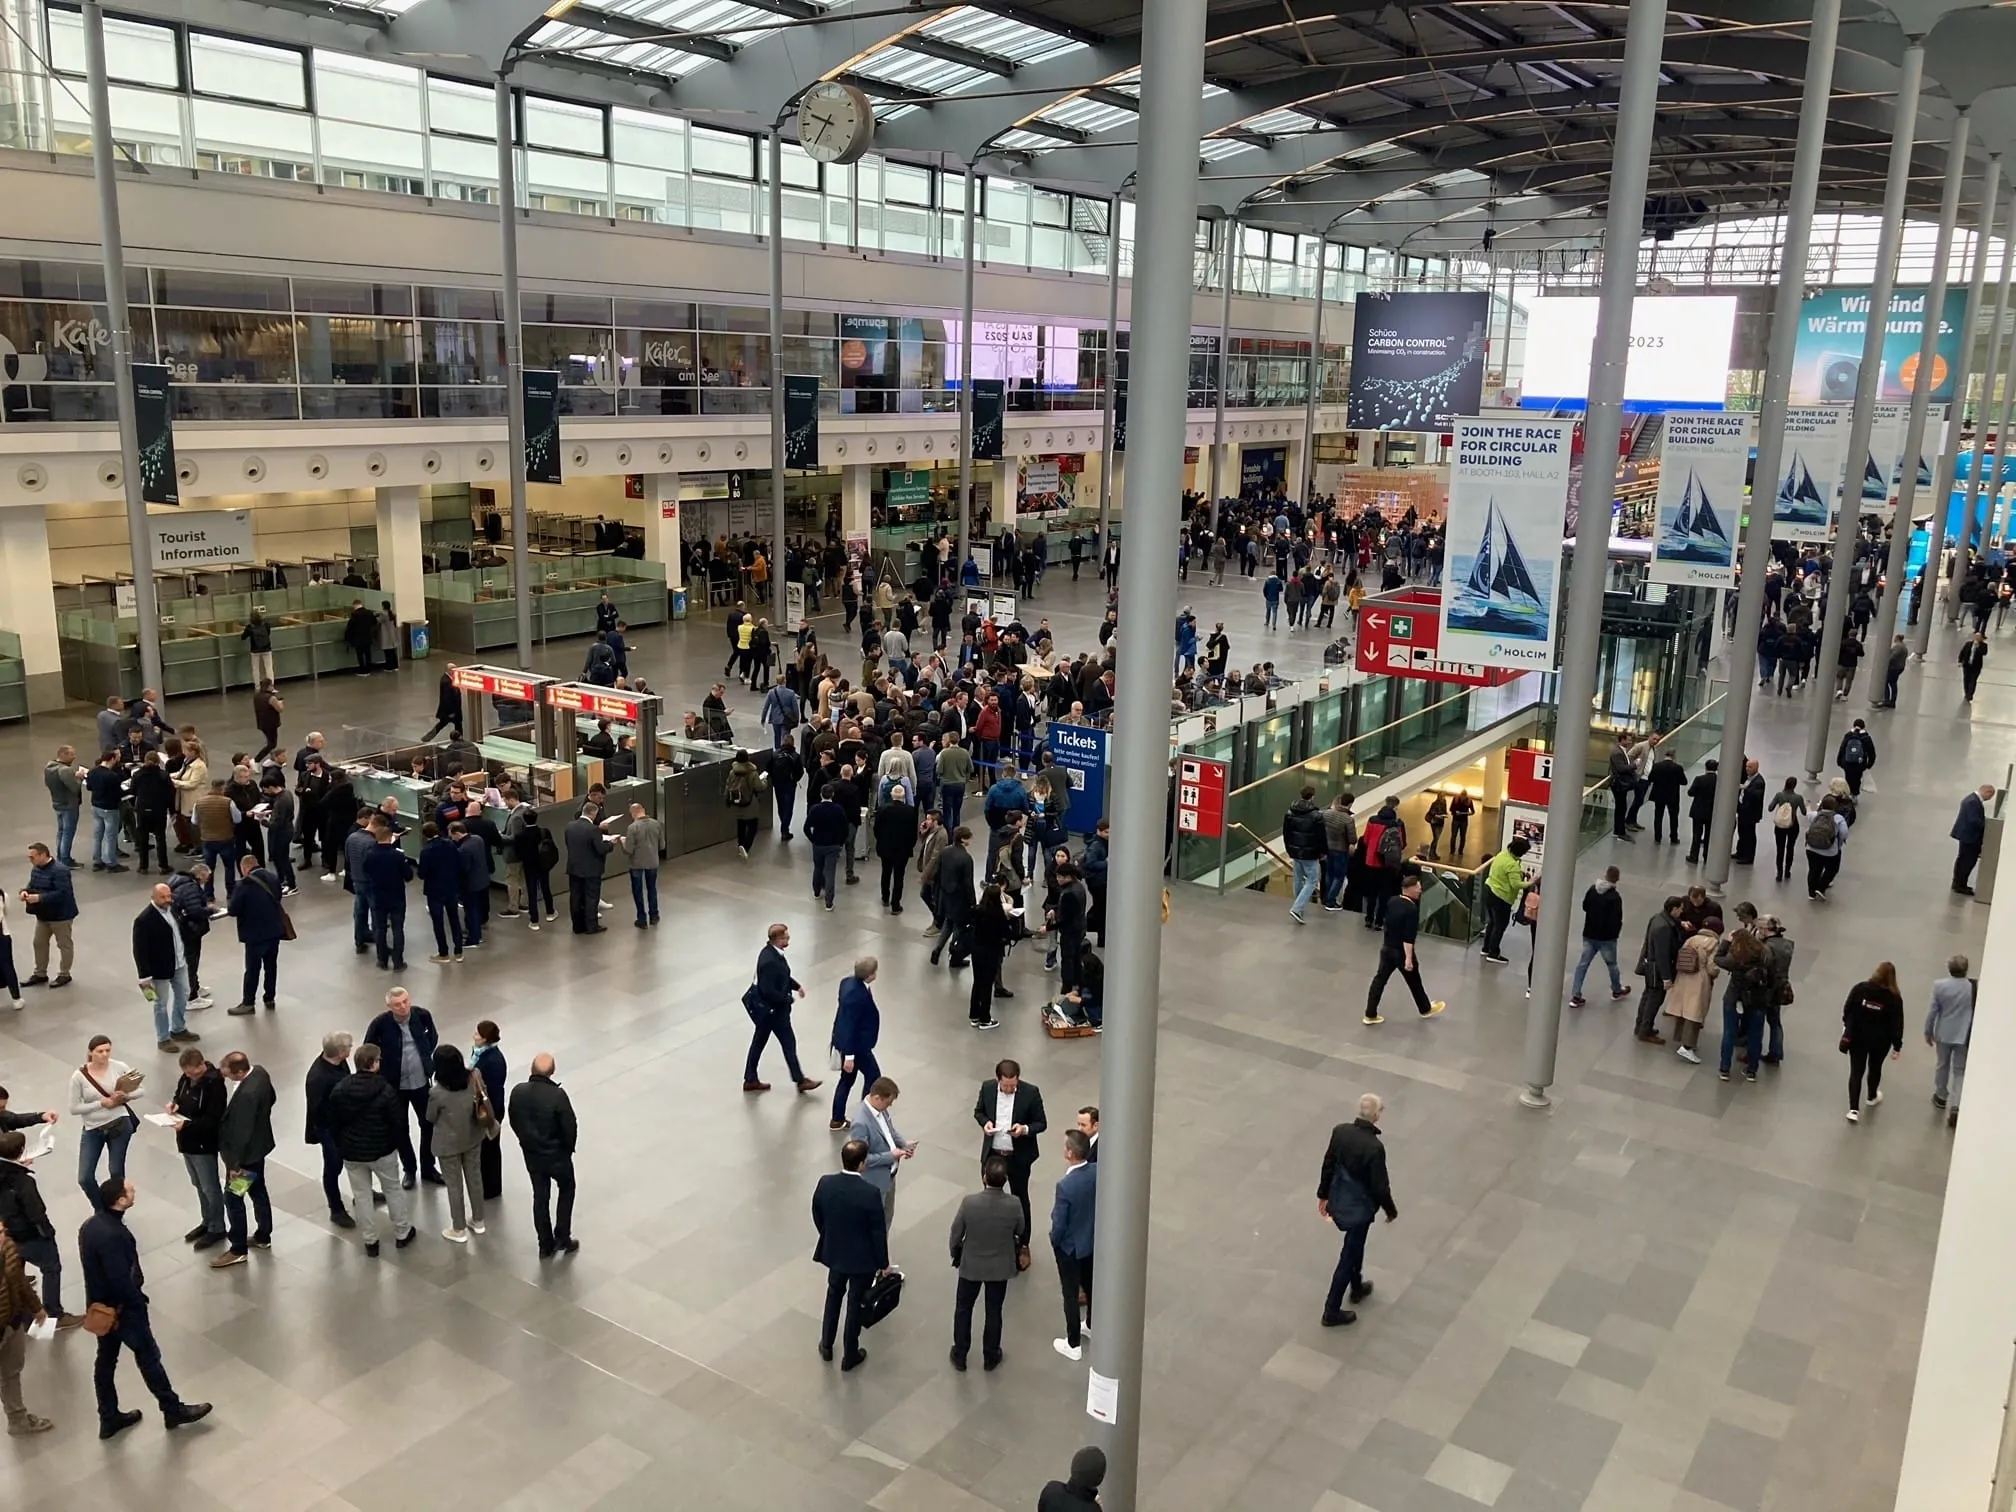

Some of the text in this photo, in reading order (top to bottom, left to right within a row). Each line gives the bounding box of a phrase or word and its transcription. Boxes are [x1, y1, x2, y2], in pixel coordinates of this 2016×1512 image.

[1368, 338, 1448, 348] CARBON CONTROL
[1628, 336, 1664, 348] 2023
[645, 340, 687, 368] Käfer
[678, 368, 720, 382] am See
[1670, 416, 1744, 426] JOIN THE RACE
[1461, 426, 1562, 439] JOIN THE RACE
[1669, 426, 1741, 436] FOR CIRCULAR
[1460, 440, 1558, 453] FOR CIRCULAR
[1668, 436, 1715, 445] BUILDING
[1459, 454, 1522, 466] BUILDING
[1458, 467, 1469, 476] AT
[1470, 468, 1501, 477] BOOTH
[1522, 470, 1545, 479] HALL
[159, 530, 206, 544] Tourist
[160, 545, 240, 561] Information
[1698, 571, 1730, 580] HOLCIM
[1504, 648, 1547, 660] HOLCIM
[1057, 730, 1097, 750] Tickets
